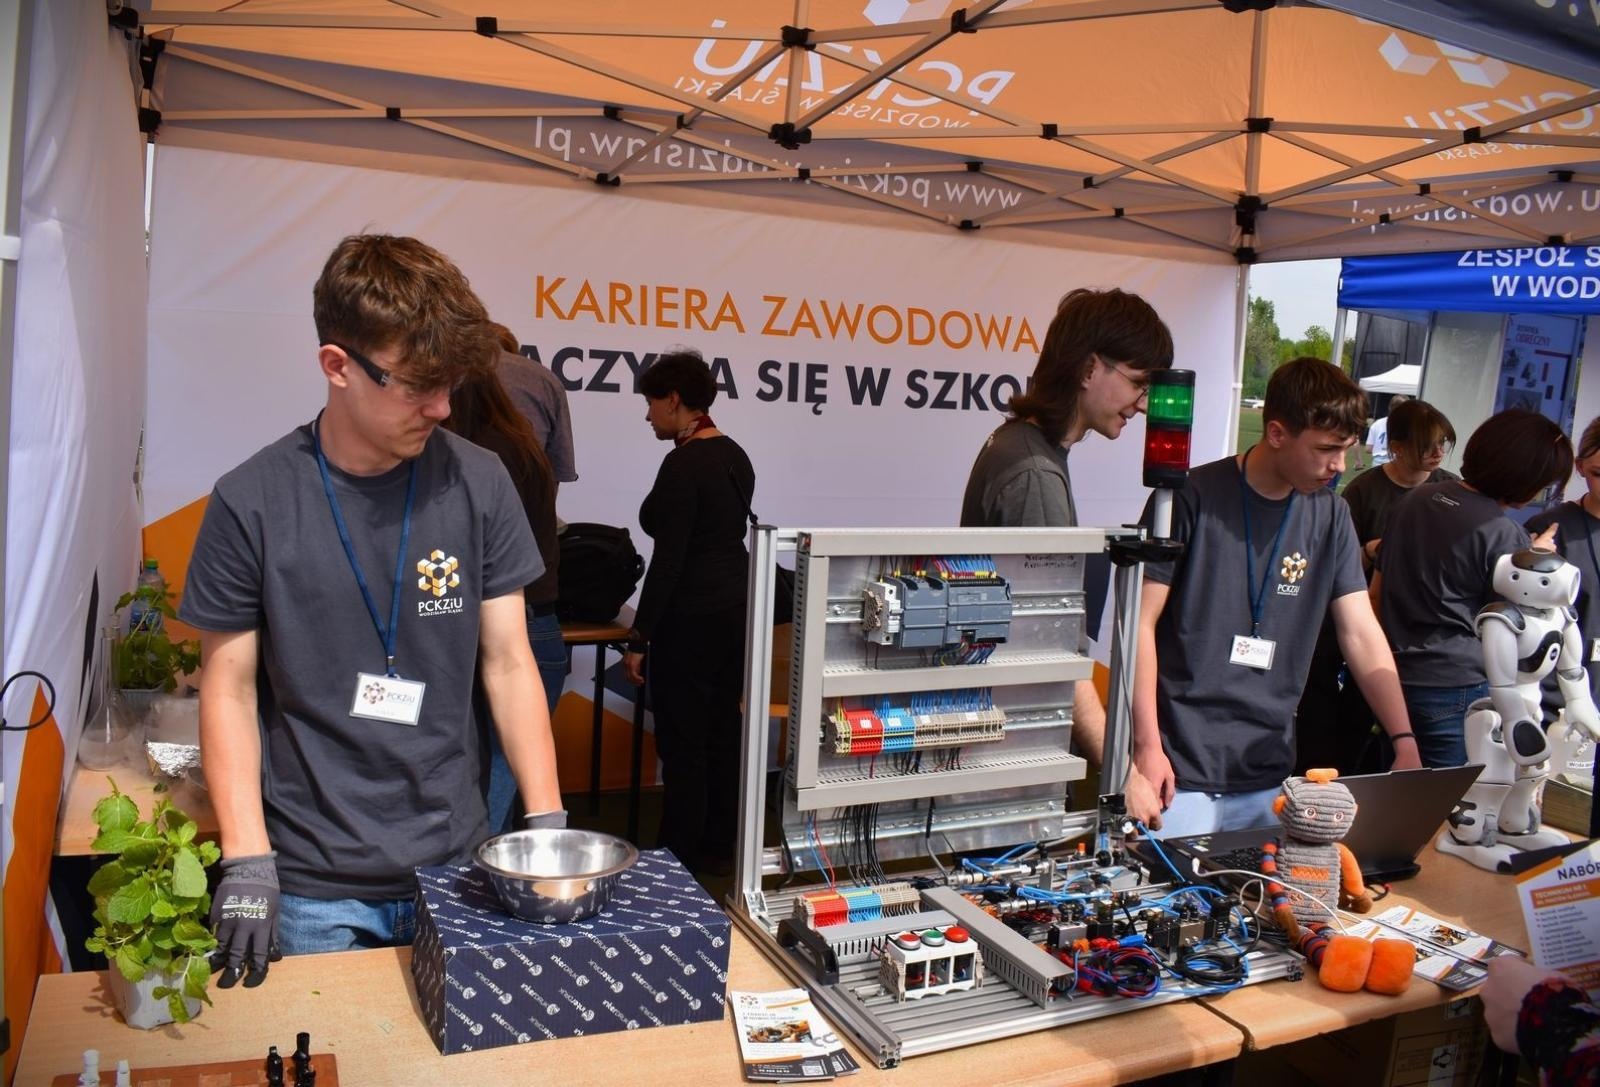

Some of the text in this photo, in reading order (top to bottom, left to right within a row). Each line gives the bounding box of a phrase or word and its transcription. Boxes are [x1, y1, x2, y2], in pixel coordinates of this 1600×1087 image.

[1491, 275, 1600, 299] W WOD
[534, 275, 1040, 354] KARIERA ZAWODOWA
[755, 359, 829, 415] SIĘ
[844, 365, 892, 408] W
[904, 368, 1036, 413] SZKO
[418, 597, 463, 613] PCKZiU
